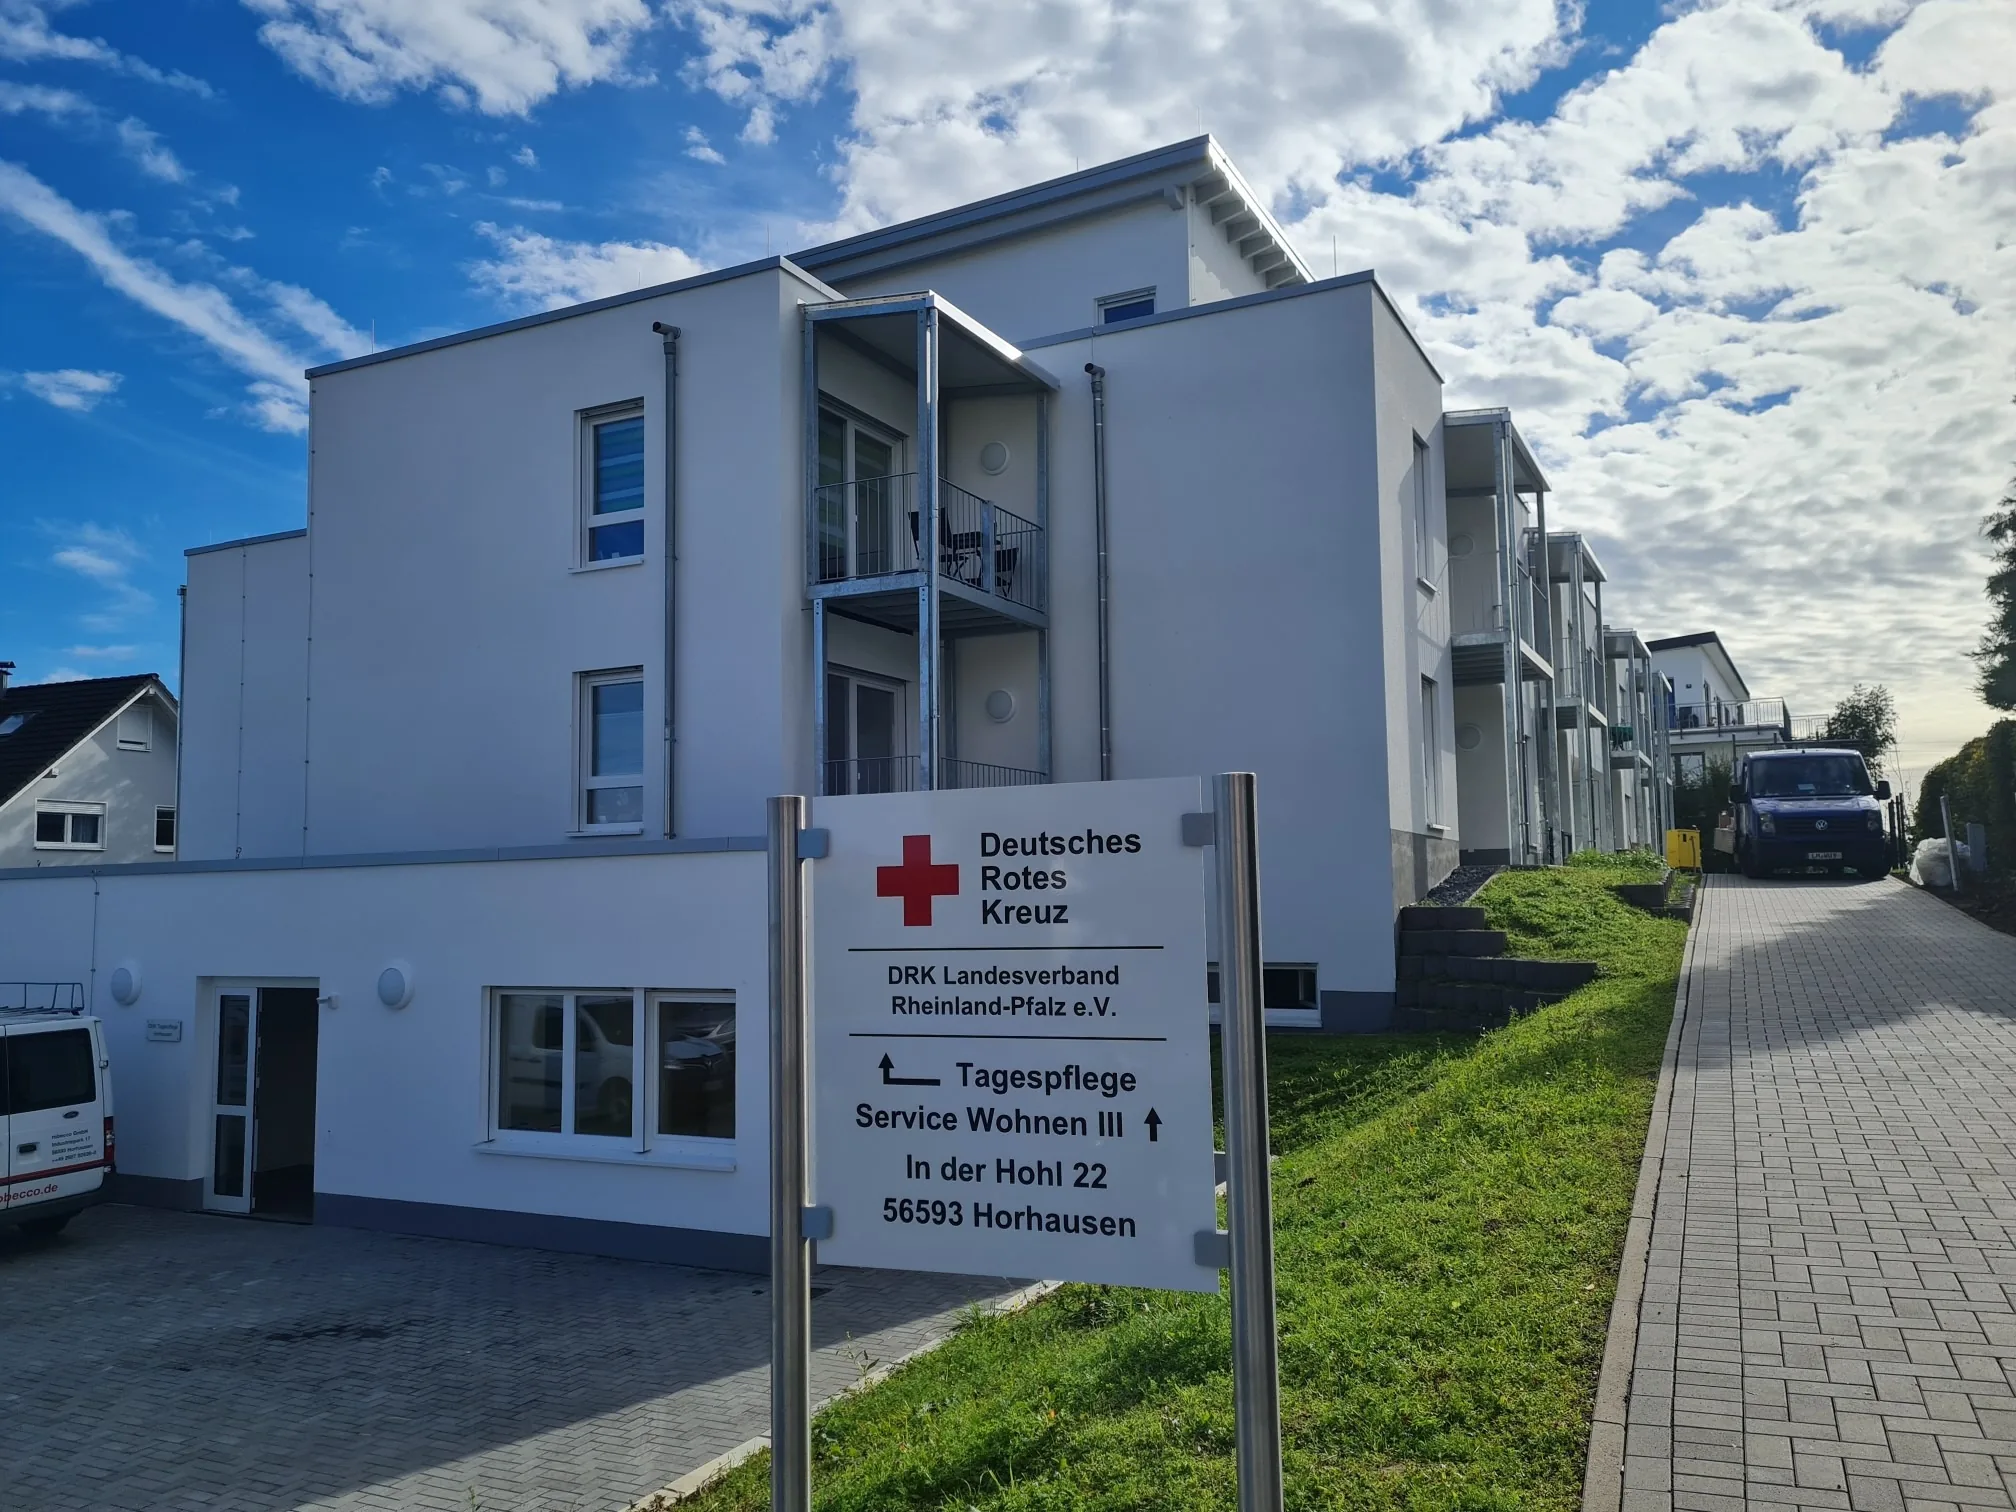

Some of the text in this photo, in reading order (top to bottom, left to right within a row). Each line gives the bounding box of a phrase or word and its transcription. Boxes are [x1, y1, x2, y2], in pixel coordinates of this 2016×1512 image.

[981, 829, 1141, 857] Deutsches
[982, 866, 1066, 890] Rotes
[983, 900, 1068, 924] Kreuz
[889, 965, 1119, 985] DRK Landesverband
[892, 996, 1116, 1016] Rheinland-Pfalz e.V.
[956, 1063, 1136, 1098] Tagespflege
[856, 1103, 1122, 1137] Service Wohnen III
[907, 1154, 1107, 1189] In der Hohl 22
[884, 1198, 1135, 1237] 56593 Horhausen
